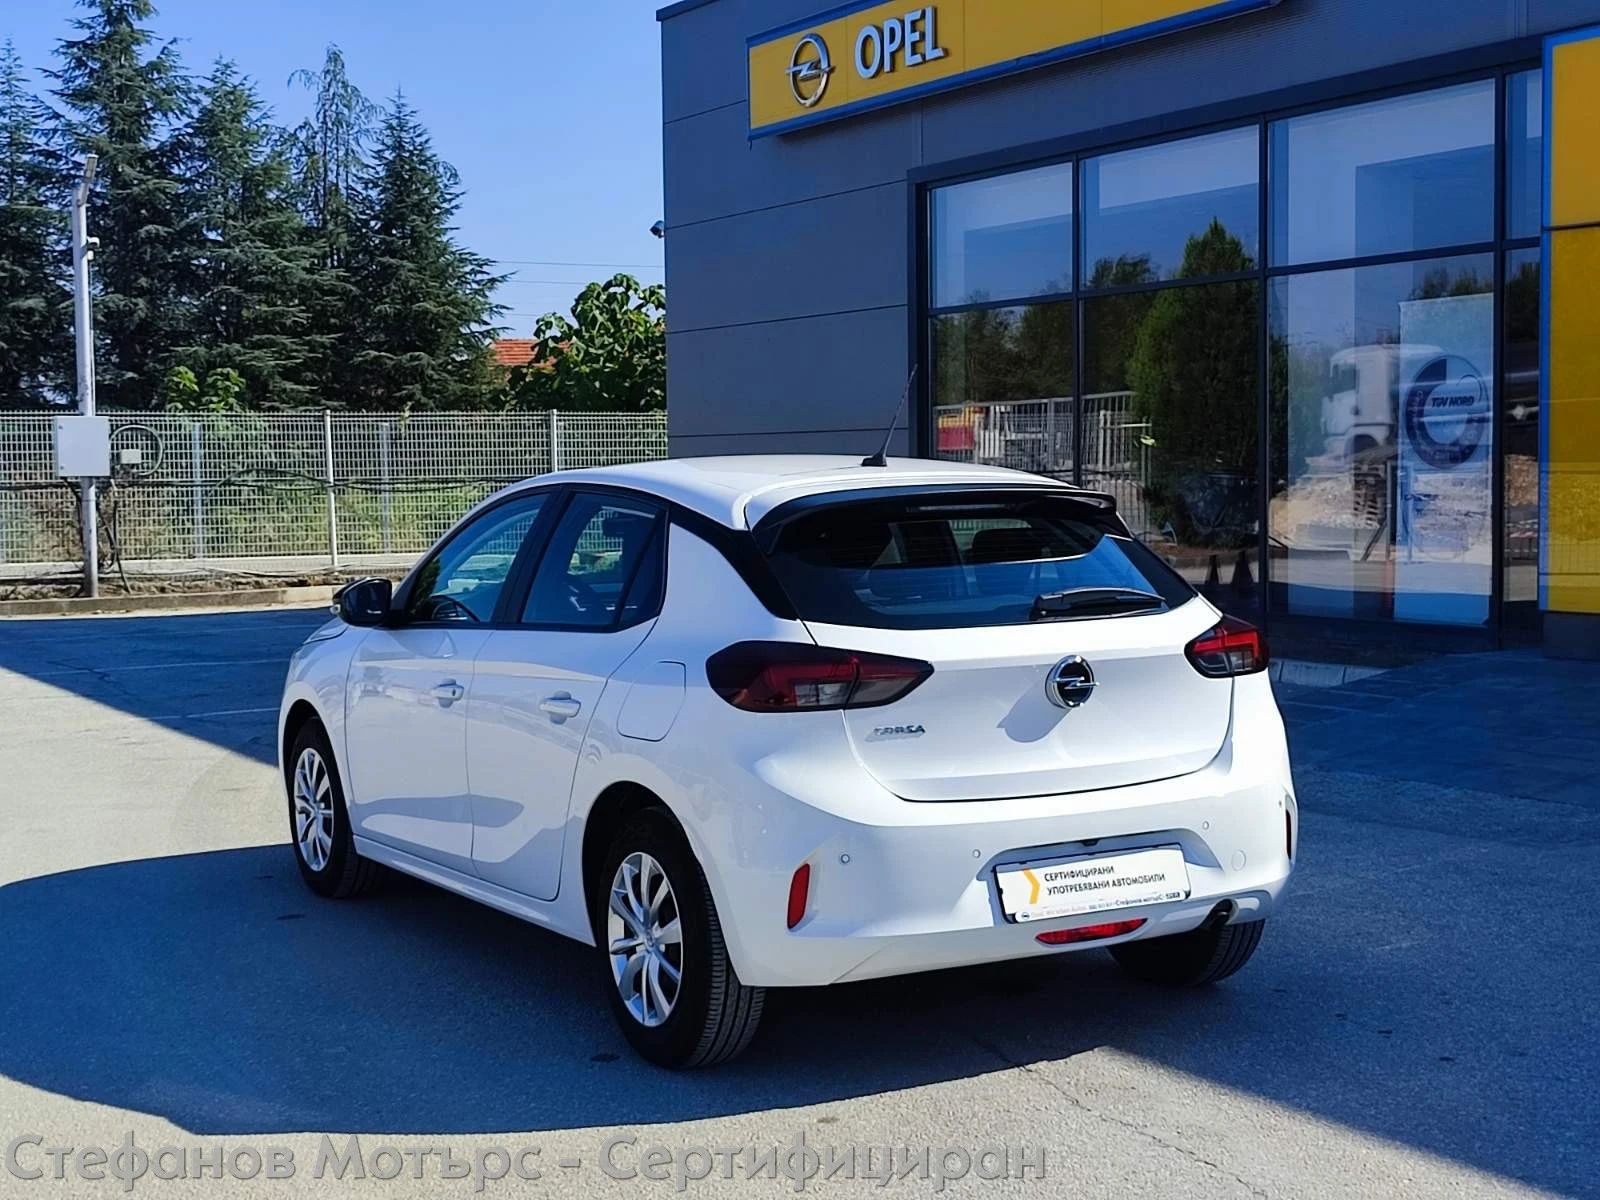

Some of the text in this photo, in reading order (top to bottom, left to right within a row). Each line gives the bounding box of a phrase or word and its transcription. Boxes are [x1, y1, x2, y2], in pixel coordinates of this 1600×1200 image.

[855, 6, 945, 79] OPEL
[1448, 395, 1475, 407] NORD
[1044, 865, 1114, 882] СЕРТИФИЦИРАНИ
[1047, 873, 1166, 896] УПОТРЕБЯВАНИ АВТОМОБИЛИ
